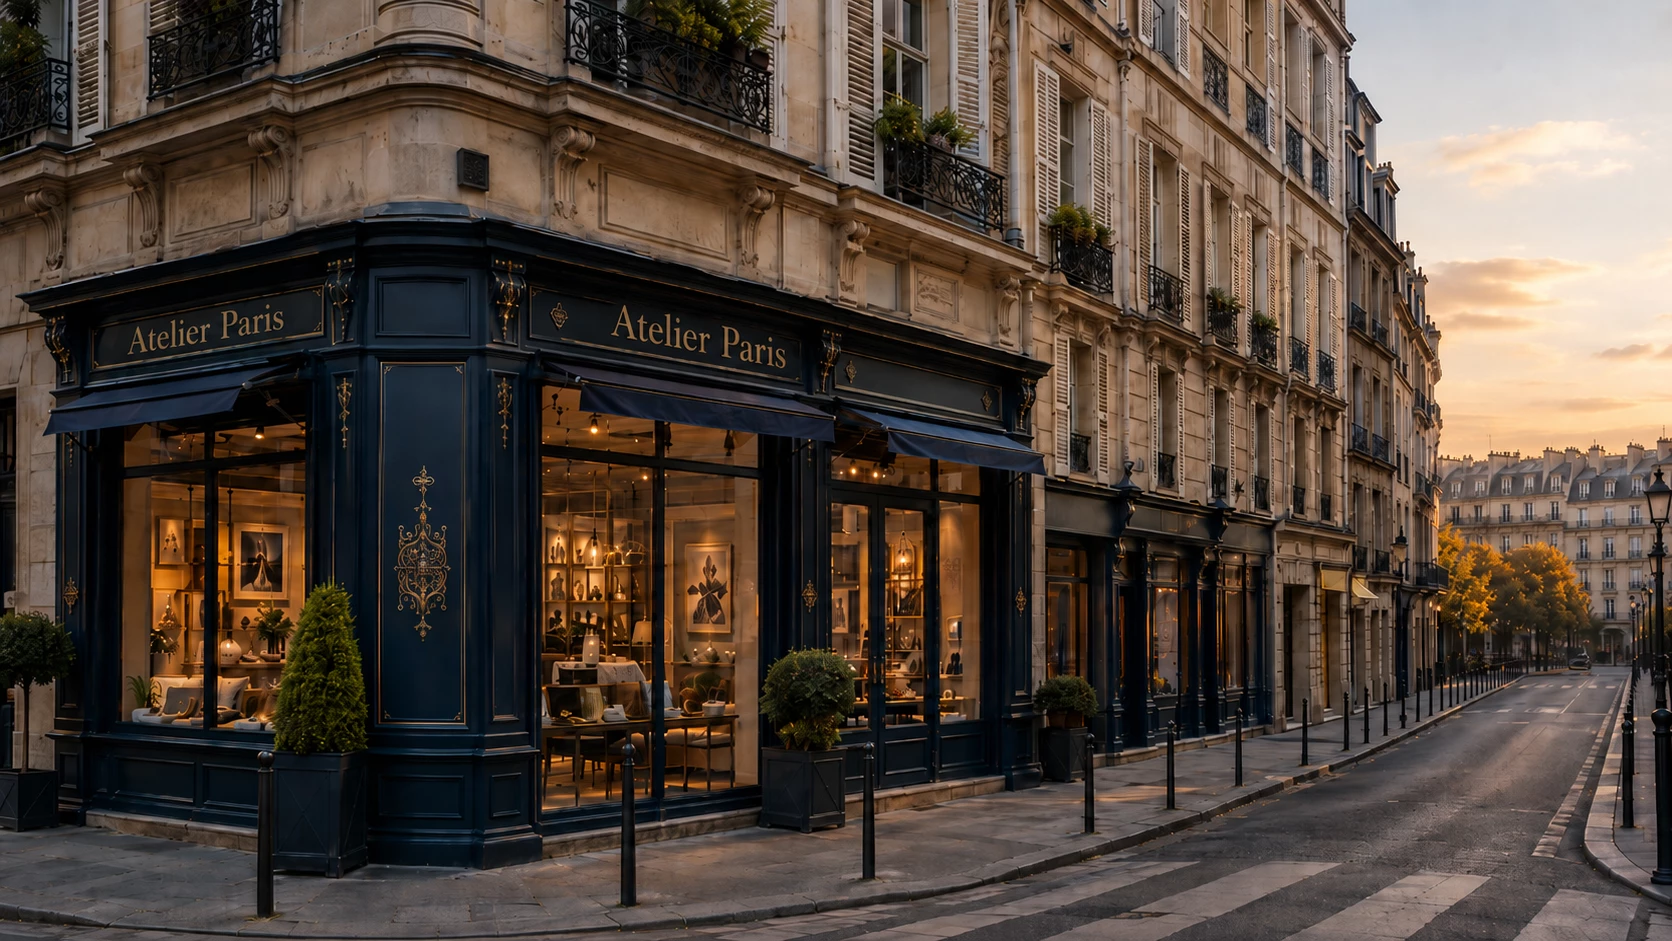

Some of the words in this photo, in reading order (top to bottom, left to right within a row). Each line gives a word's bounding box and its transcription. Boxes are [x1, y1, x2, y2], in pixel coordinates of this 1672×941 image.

[126, 319, 211, 355] Atelier
[220, 304, 285, 340] Paris
[610, 305, 711, 355] Atelier
[721, 325, 787, 370] Paris
